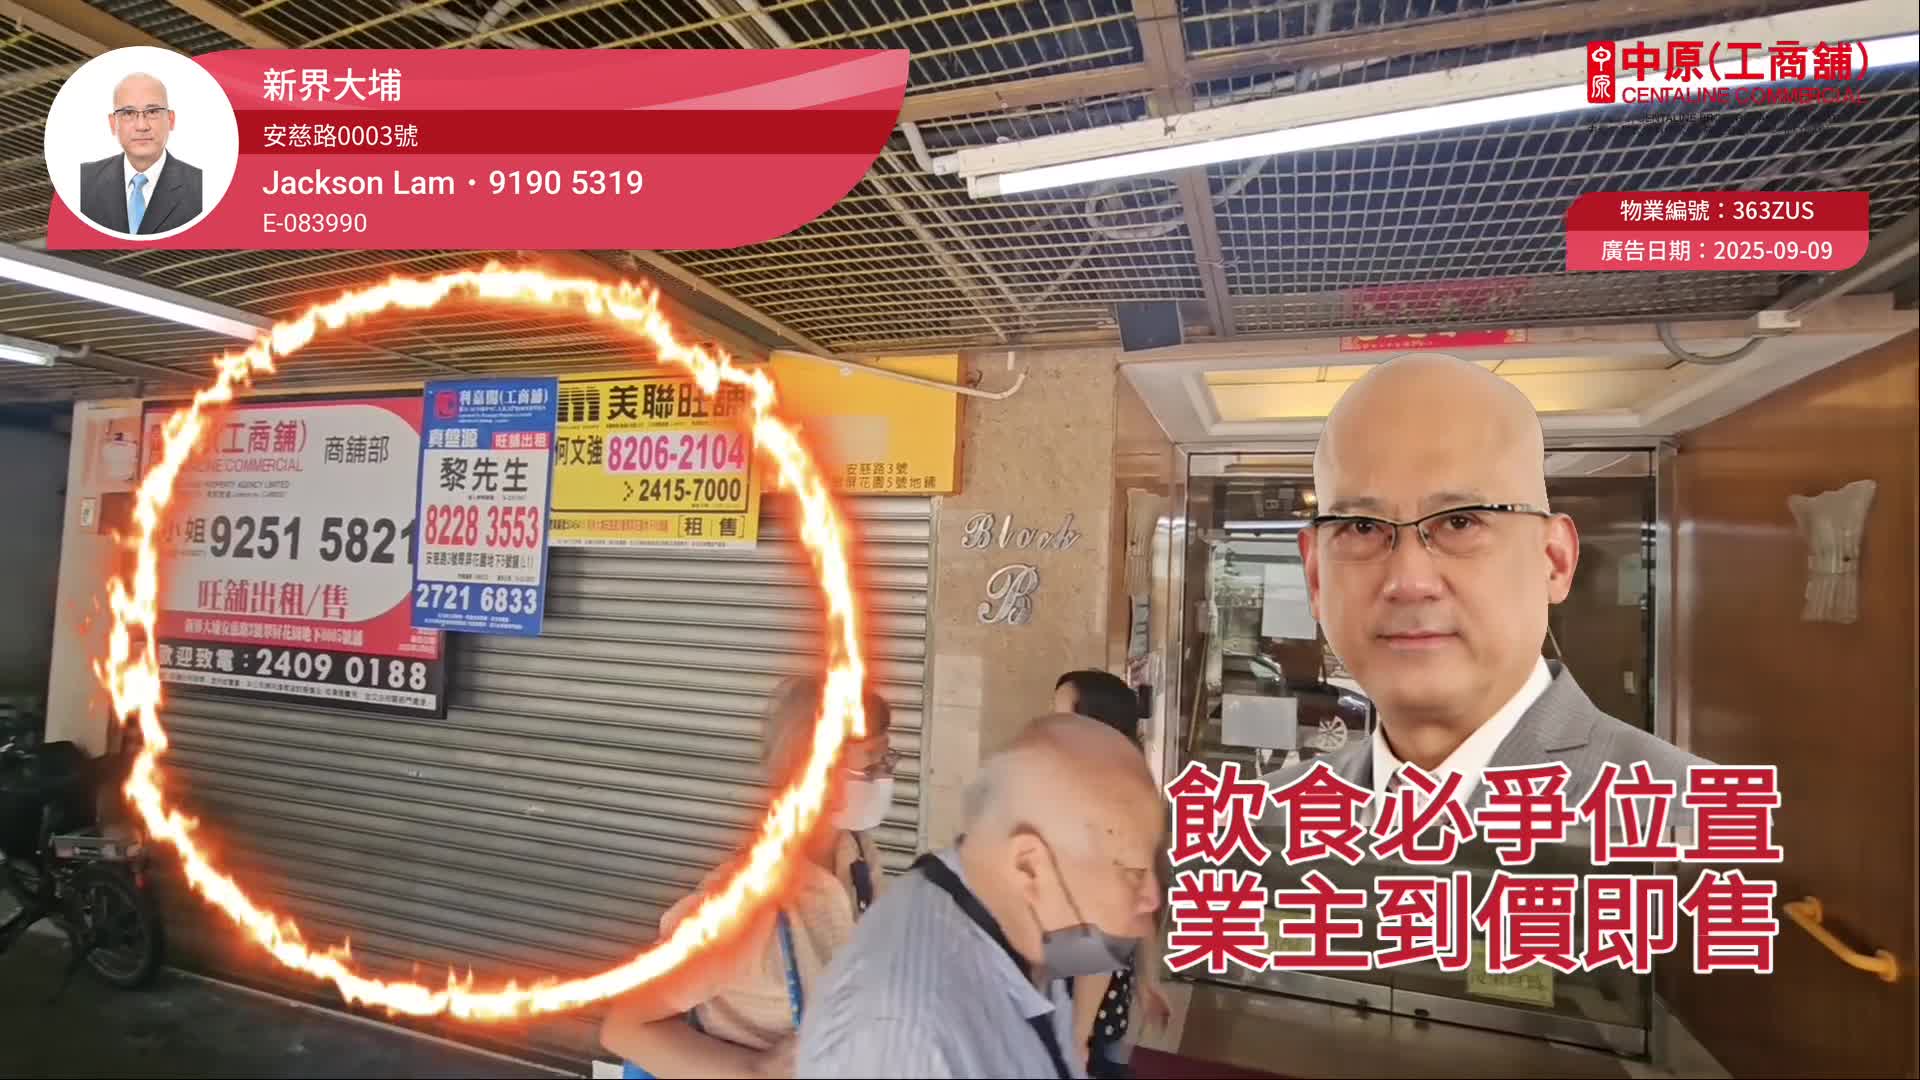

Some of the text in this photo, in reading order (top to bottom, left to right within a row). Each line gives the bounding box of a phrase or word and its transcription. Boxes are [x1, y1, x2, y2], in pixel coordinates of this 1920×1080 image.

[324, 434, 390, 465] 商舖部
[607, 433, 745, 472] 8206-2104
[440, 457, 529, 492] 黎先生
[639, 478, 742, 502] 2415-7000
[210, 515, 419, 566] 9251 5821
[425, 504, 540, 549] 8228 3553
[684, 516, 703, 537] 租
[719, 517, 737, 537] 售
[961, 512, 1082, 550] Block
[415, 583, 538, 615] 2721 6833
[977, 562, 1041, 625] B
[256, 648, 334, 682] 2409
[344, 655, 428, 691] 0188
